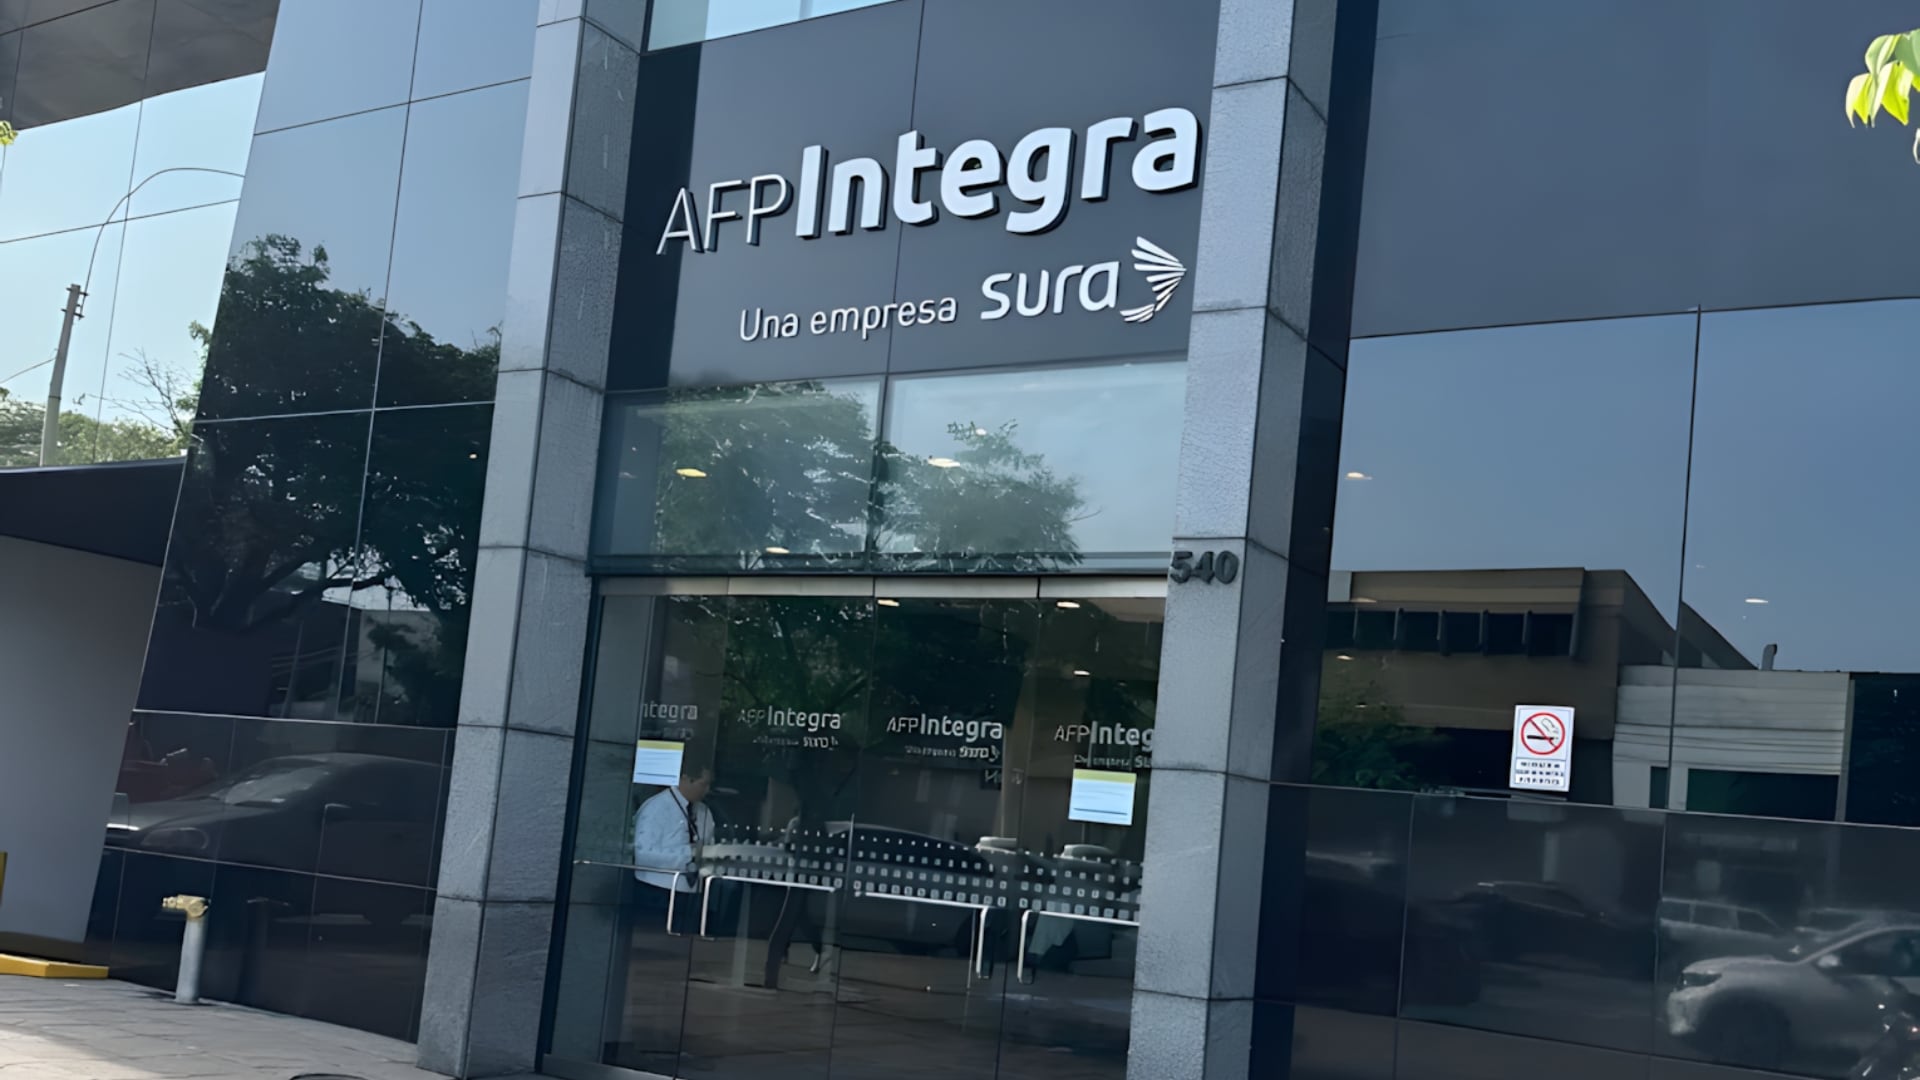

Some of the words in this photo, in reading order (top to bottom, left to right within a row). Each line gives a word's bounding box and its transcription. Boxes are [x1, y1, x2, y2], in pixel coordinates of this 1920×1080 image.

[739, 308, 800, 342] Una
[810, 296, 957, 340] empresa
[980, 260, 1120, 320] sura
[1170, 551, 1239, 585] 540
